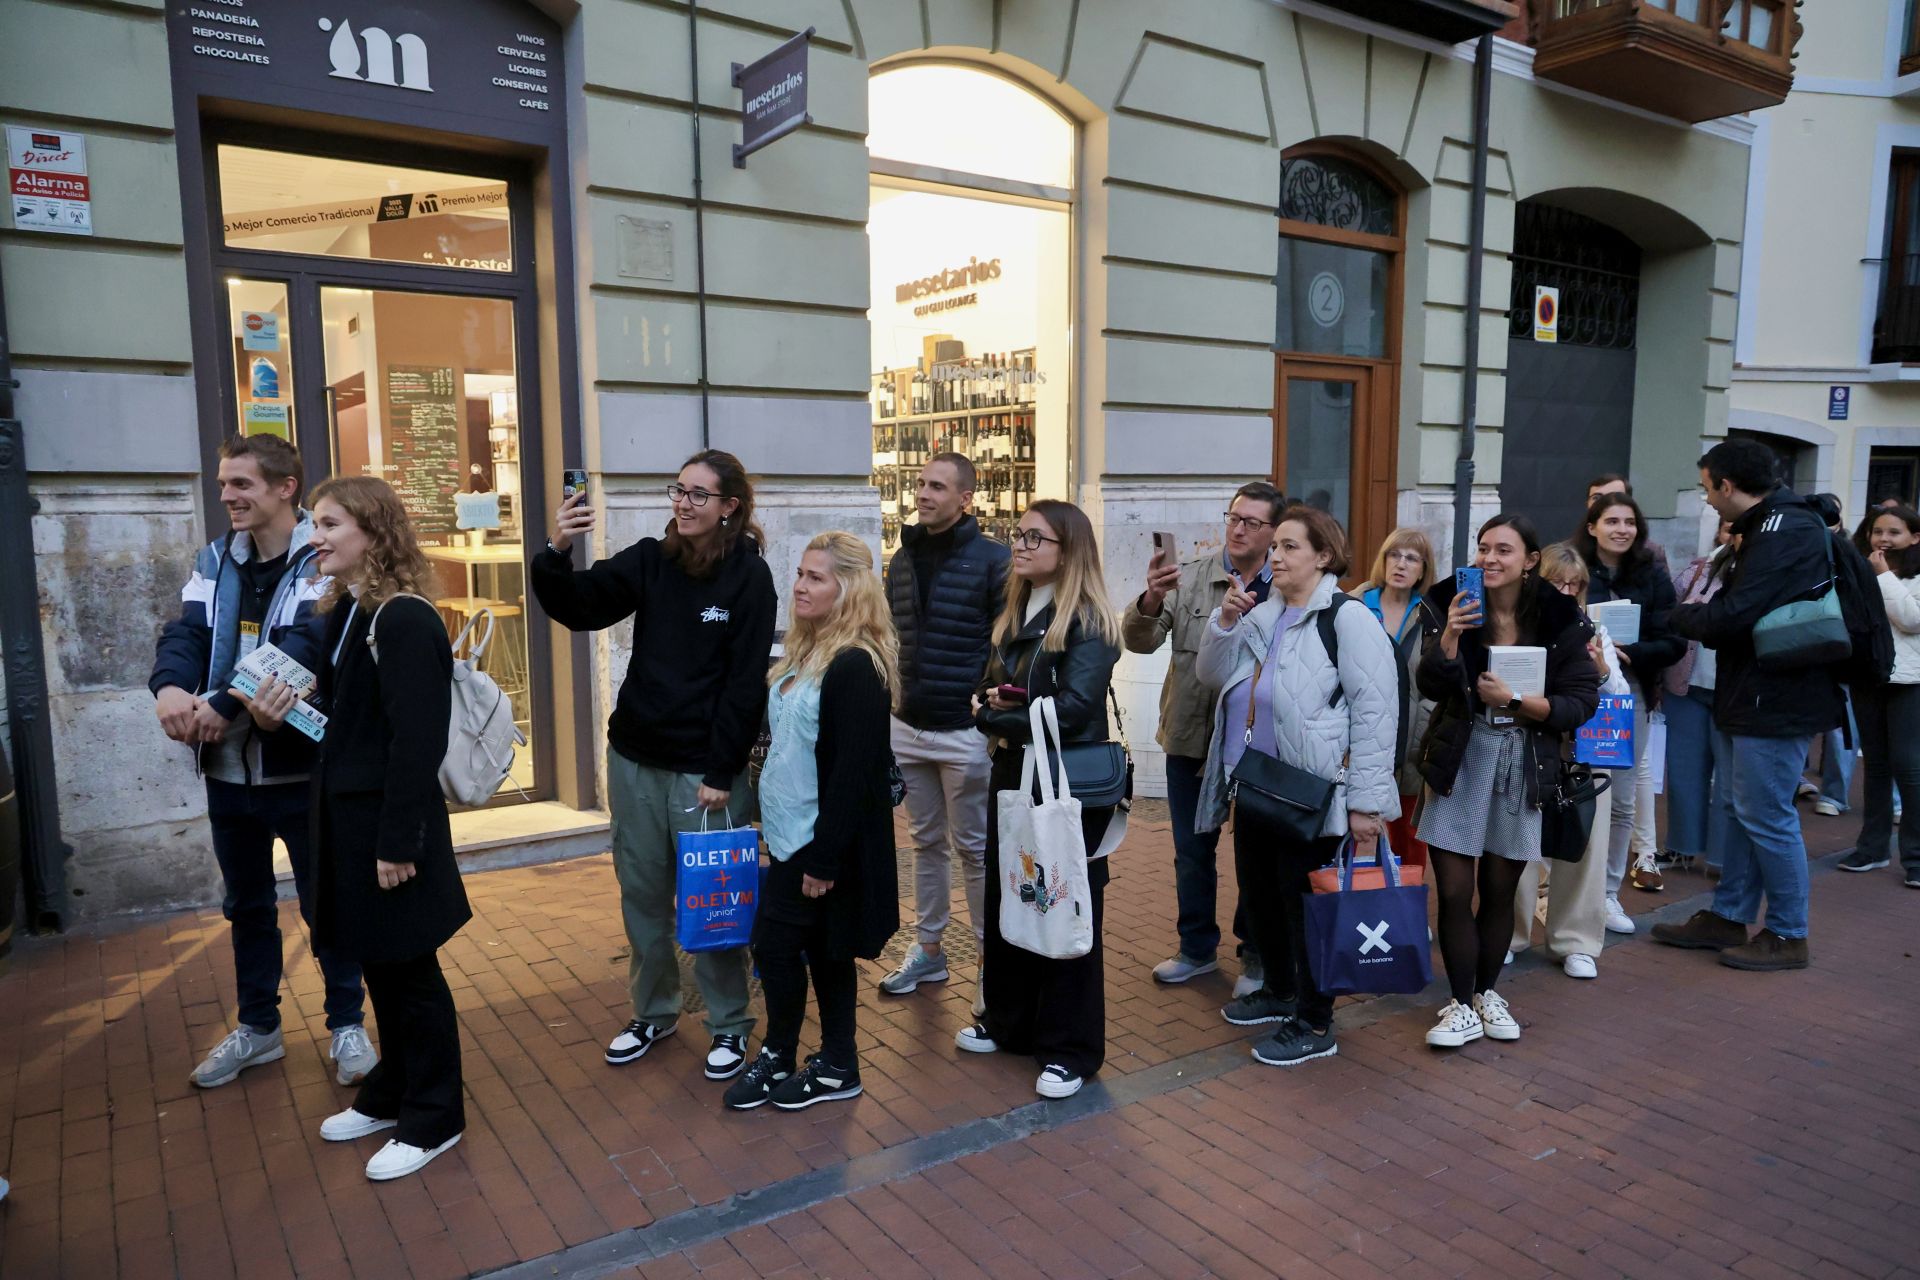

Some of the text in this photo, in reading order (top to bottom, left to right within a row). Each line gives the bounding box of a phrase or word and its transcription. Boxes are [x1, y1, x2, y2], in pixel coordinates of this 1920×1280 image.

[191, 8, 259, 28] PANADERÍA
[192, 27, 265, 46] REPOSTERÍA
[516, 33, 545, 46] VINOS
[193, 45, 270, 64] CHOCOLATES
[497, 46, 546, 61] CERVEZAS
[508, 64, 547, 78] LICORES
[492, 77, 548, 93] CONSERVAS
[746, 72, 803, 114] mesetarios
[519, 99, 549, 110] CAFÉS
[22, 150, 75, 165] Direct
[16, 173, 84, 190] Alarma
[441, 191, 502, 206] Premio Mejor
[232, 219, 263, 231] Mejor
[265, 213, 317, 227] Comercio
[317, 206, 375, 221] Tradicional
[896, 256, 1001, 303] mesetarios
[914, 292, 978, 317] GLU GLU LOUNGE
[1321, 284, 1333, 311] 2
[931, 364, 1048, 385] mesetarios
[253, 404, 281, 412] Cheque
[258, 652, 277, 666] JAVIER
[263, 656, 289, 675] CASTILLO
[240, 666, 261, 681] JAVIER
[1580, 728, 1631, 740] OLETVM
[683, 847, 756, 867] OLETVM
[686, 891, 753, 909] OLETVM
[706, 908, 736, 921] junior
